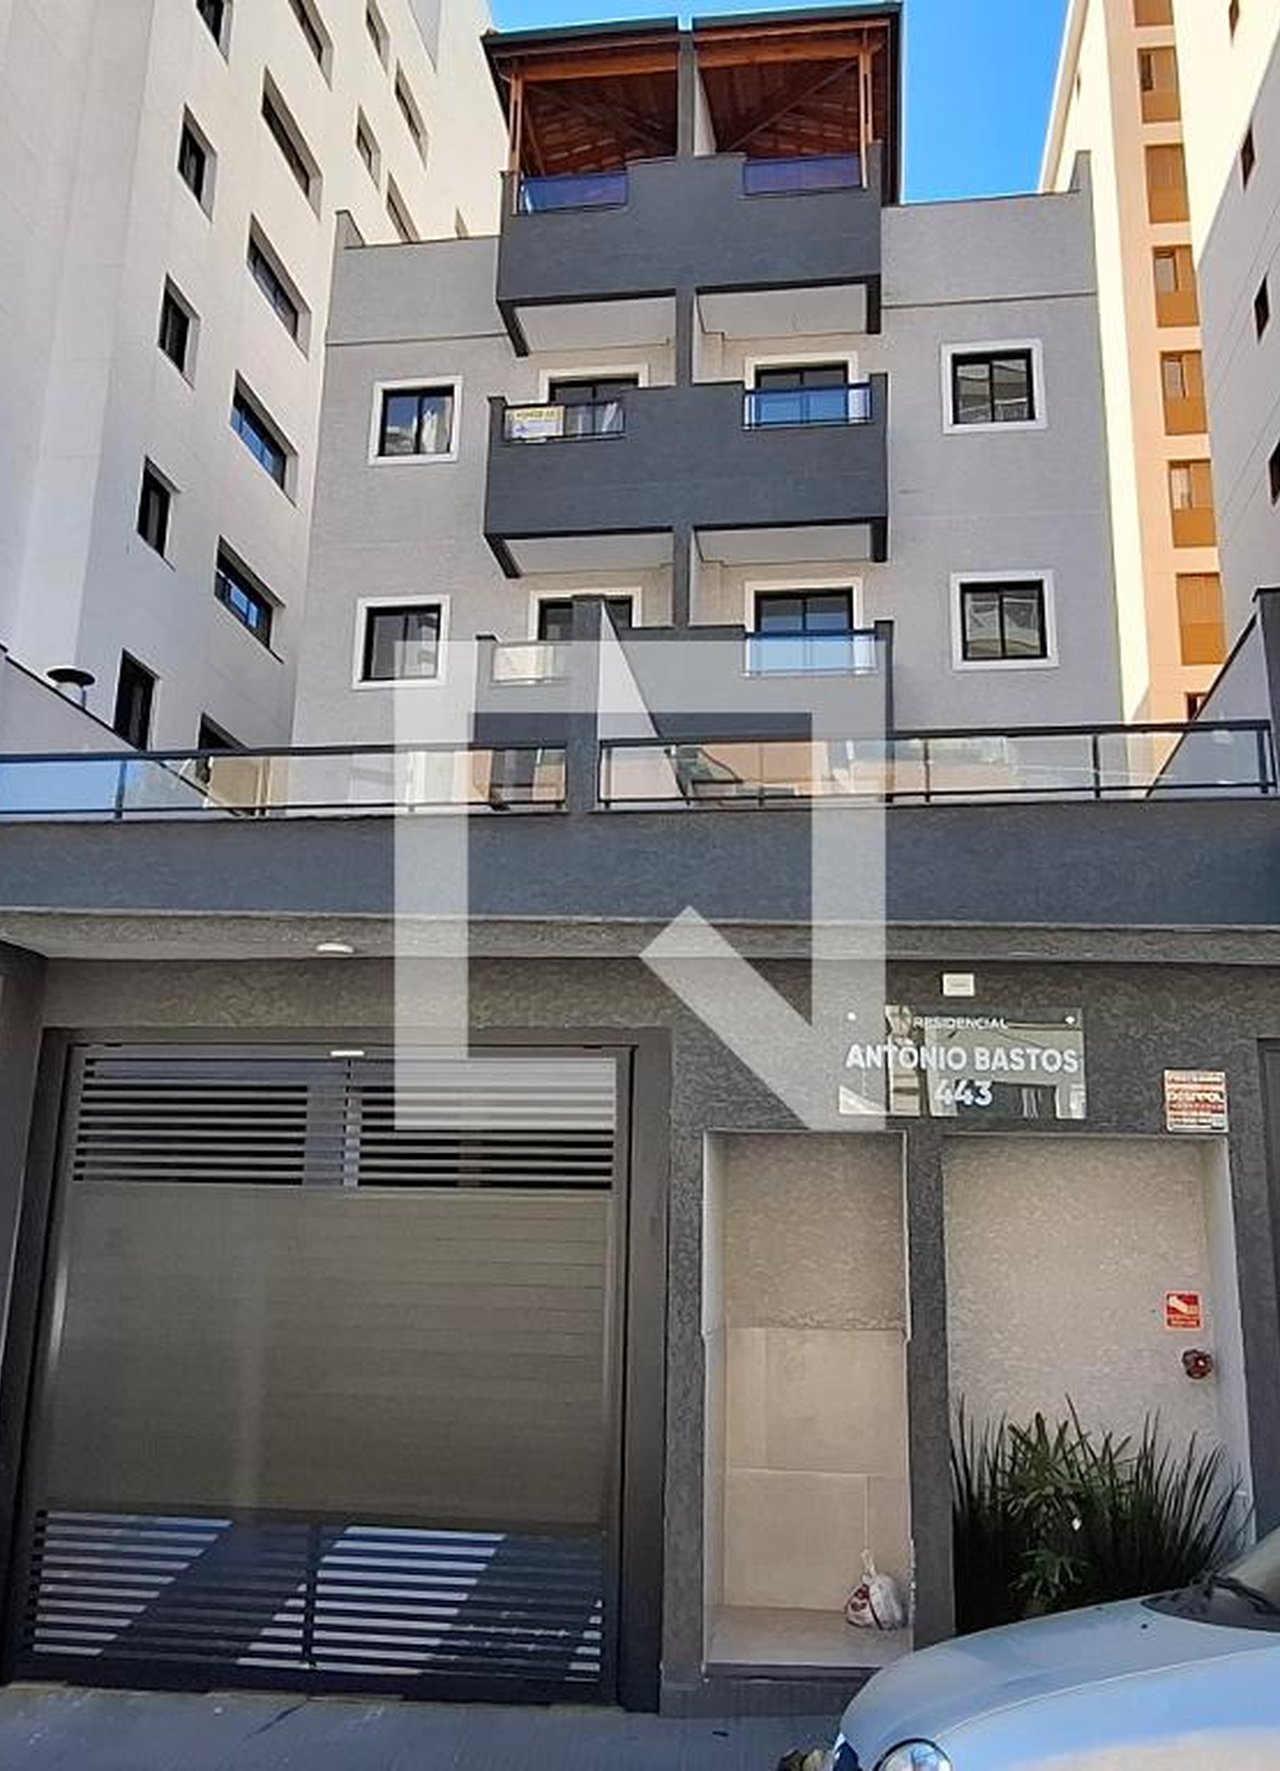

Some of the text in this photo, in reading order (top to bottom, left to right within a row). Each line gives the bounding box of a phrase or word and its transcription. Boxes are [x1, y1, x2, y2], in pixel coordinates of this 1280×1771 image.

[912, 1015, 1008, 1031] RESIDENCIAL
[973, 1045, 1079, 1073] BASTOS
[933, 1078, 993, 1106] 443
